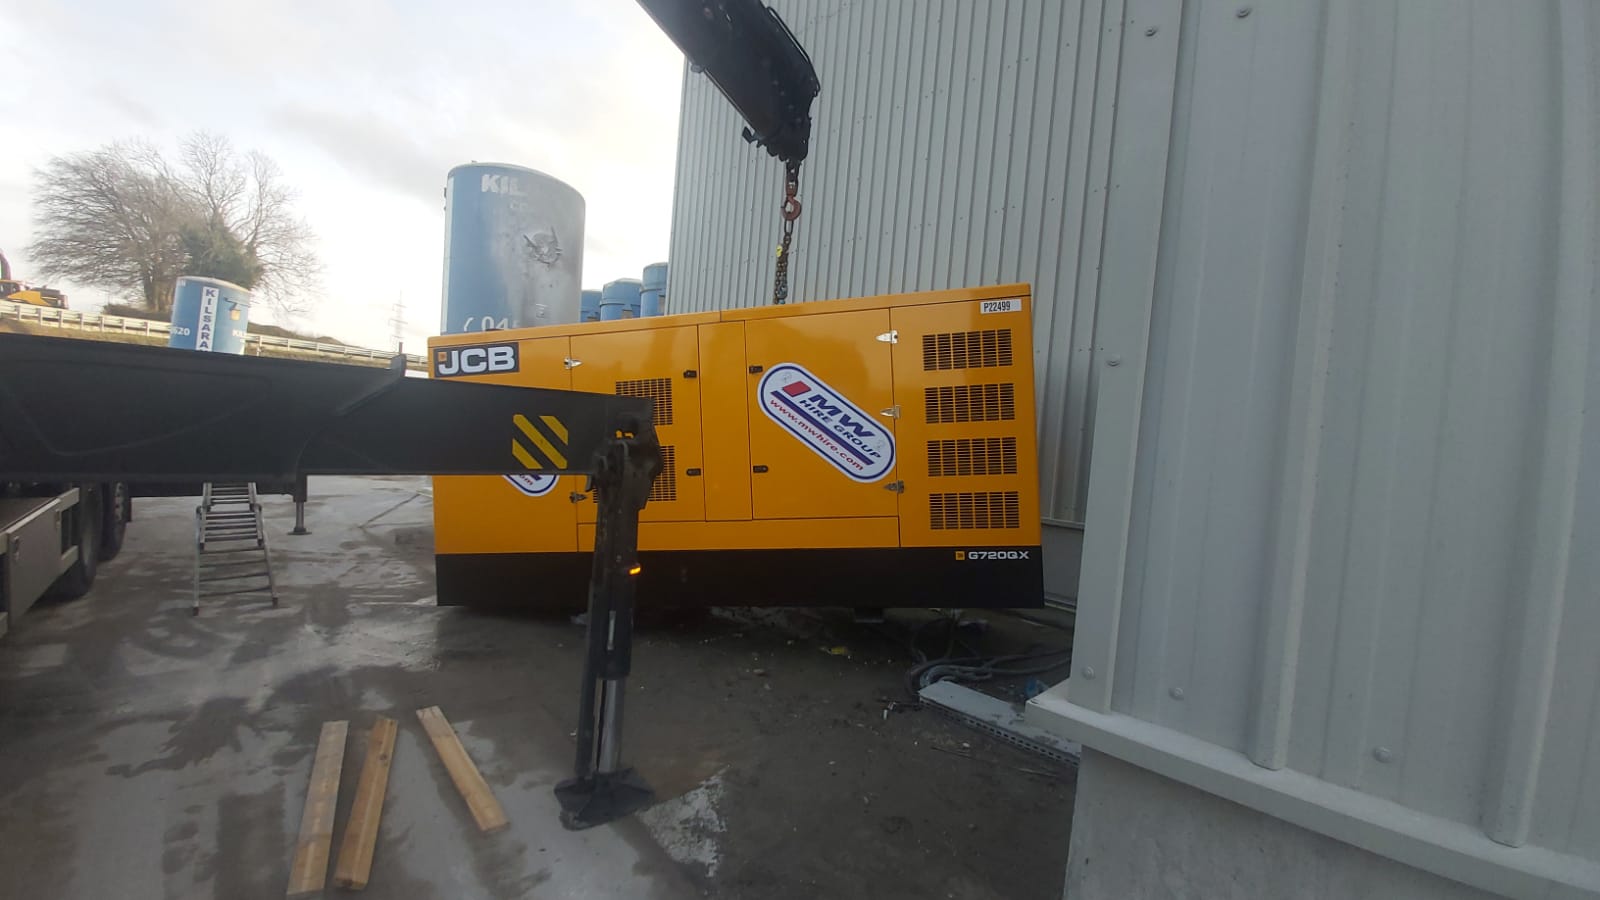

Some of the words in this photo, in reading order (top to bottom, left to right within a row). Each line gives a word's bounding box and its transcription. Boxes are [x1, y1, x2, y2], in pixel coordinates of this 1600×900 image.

[983, 300, 1011, 312] P22499
[438, 345, 516, 375] JCB
[770, 399, 864, 471] www.mwhire.com
[799, 399, 833, 424] HIRE
[833, 424, 882, 459] GROUP
[808, 394, 876, 438] MW
